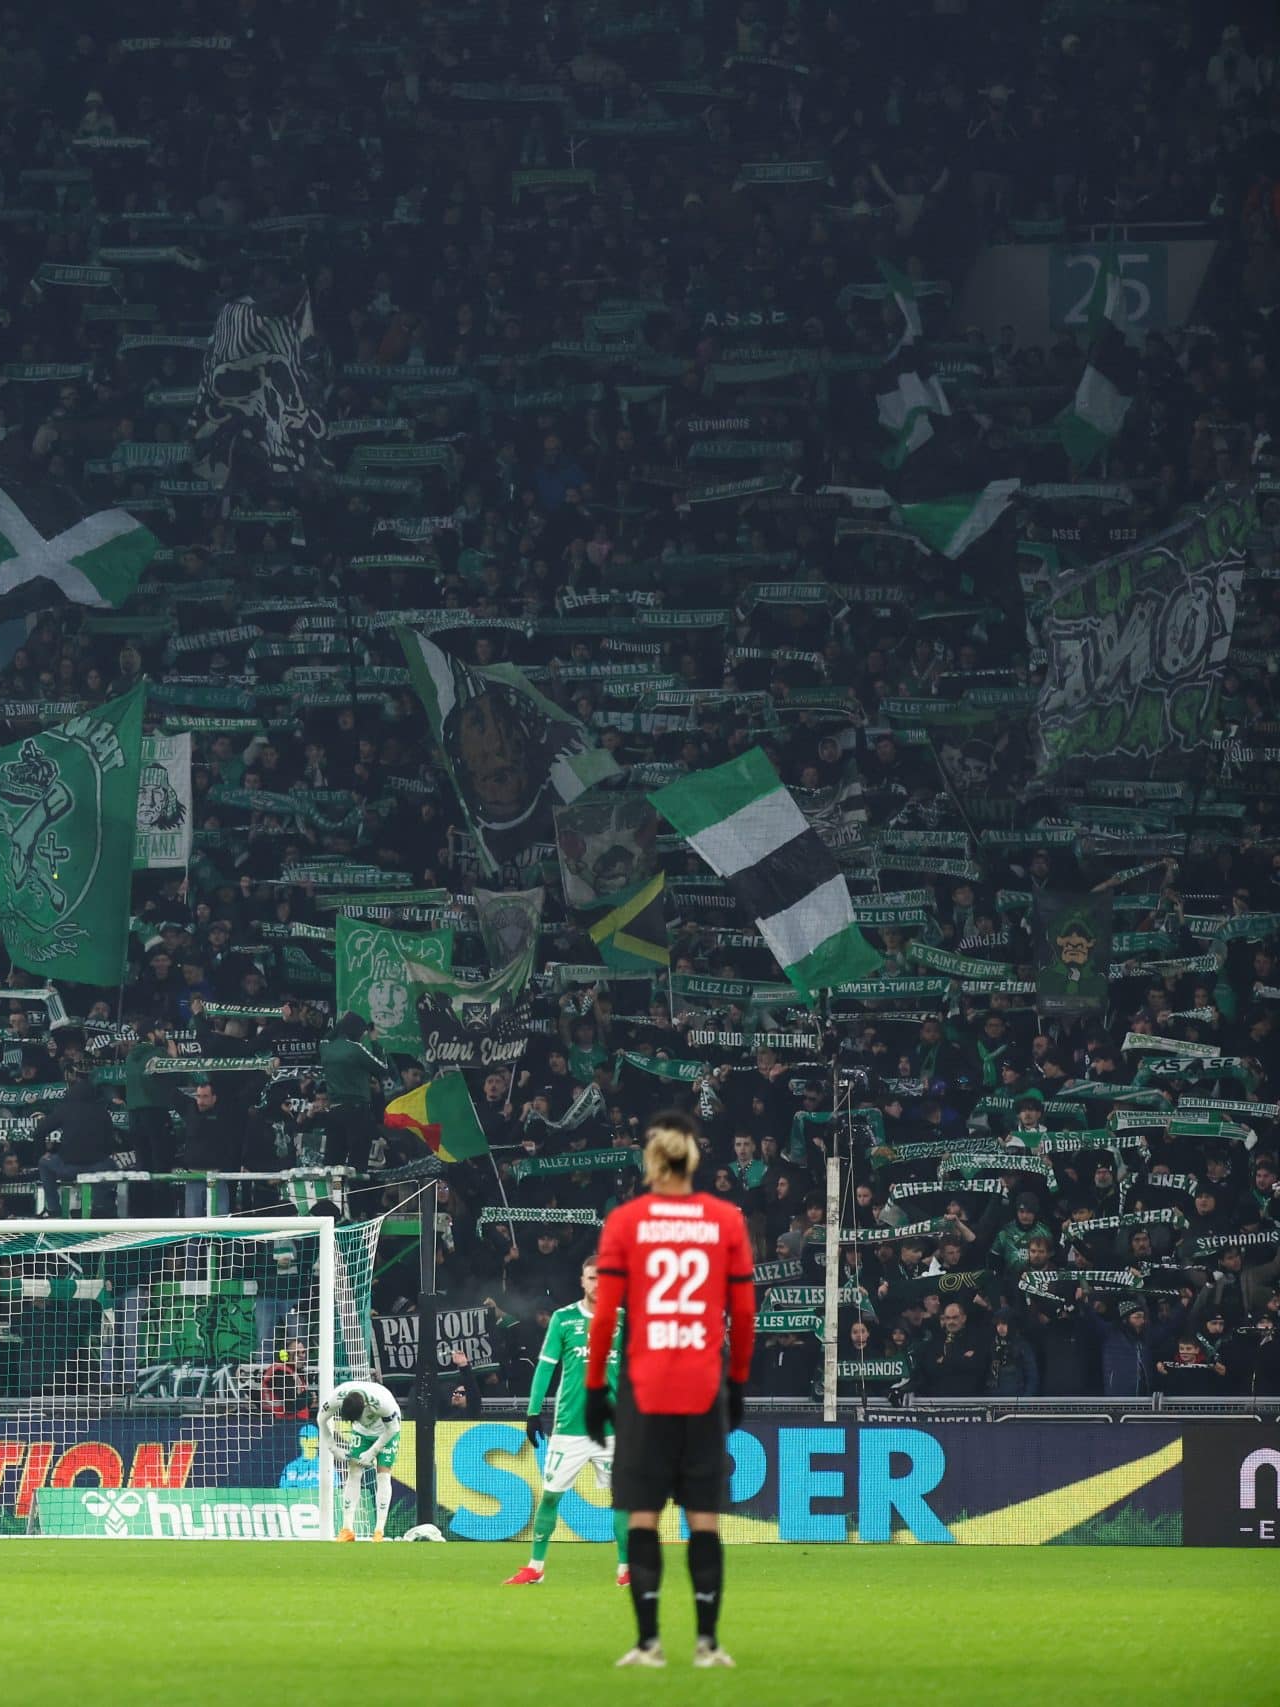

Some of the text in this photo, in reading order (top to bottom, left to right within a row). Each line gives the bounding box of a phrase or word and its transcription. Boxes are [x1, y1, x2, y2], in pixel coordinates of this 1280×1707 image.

[1065, 254, 1150, 323] 25
[875, 911, 895, 922] LES
[926, 950, 1005, 976] SAINT-ETIENNE
[688, 981, 743, 995] ALLEZ LES
[716, 1033, 742, 1047] SUD
[21, 1090, 39, 1103] les
[986, 1098, 1080, 1114] SAINT TIENNE
[539, 1152, 628, 1168] ALLEZ LES VERTS
[867, 1228, 890, 1240] LES
[894, 1224, 932, 1238] VERTS
[1196, 1230, 1280, 1249] STÉPHANOIS
[784, 1259, 804, 1275] LES
[645, 1248, 709, 1315] 22
[1033, 1270, 1060, 1283] SUD
[771, 1287, 802, 1304] ALLEZ
[805, 1288, 825, 1304] LES
[763, 1313, 824, 1328] LES VERTS
[383, 1308, 489, 1350] PATOUT
[835, 1361, 904, 1378] TÉPHANOIS
[548, 1451, 564, 1471] 17
[147, 1498, 321, 1535] humme
